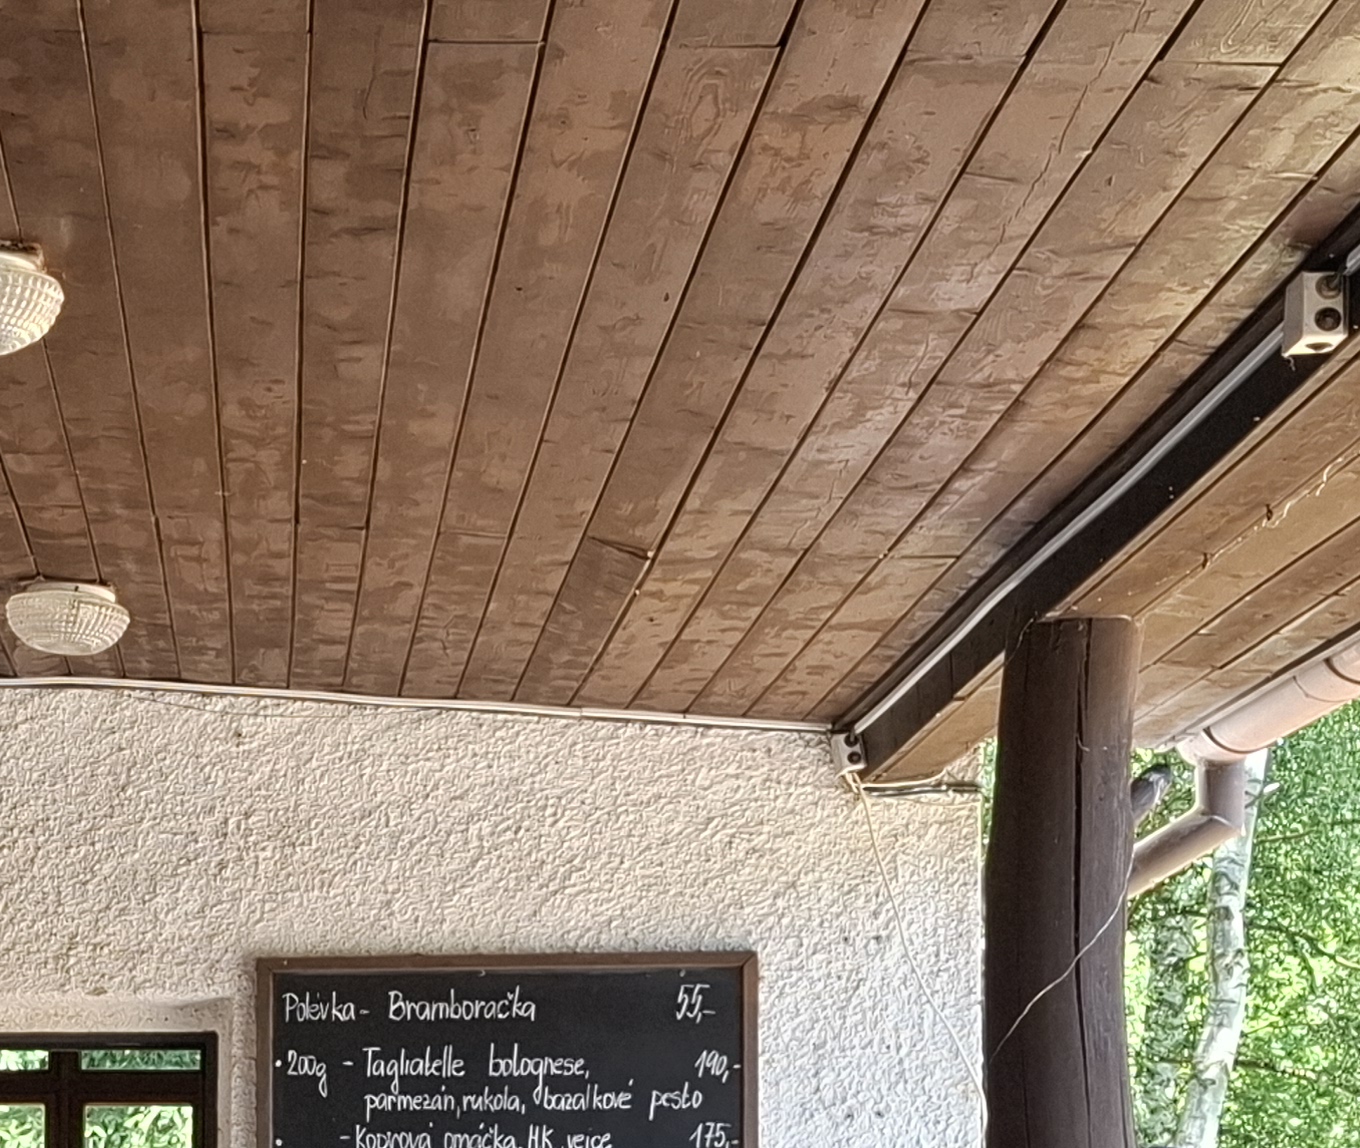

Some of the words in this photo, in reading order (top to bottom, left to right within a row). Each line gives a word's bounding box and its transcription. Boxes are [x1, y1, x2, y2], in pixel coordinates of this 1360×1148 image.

[387, 987, 536, 1022] Bramboračka
[287, 1051, 328, 1097] 200g
[363, 1045, 465, 1094] Tagliatelle
[649, 1085, 703, 1121] pesto
